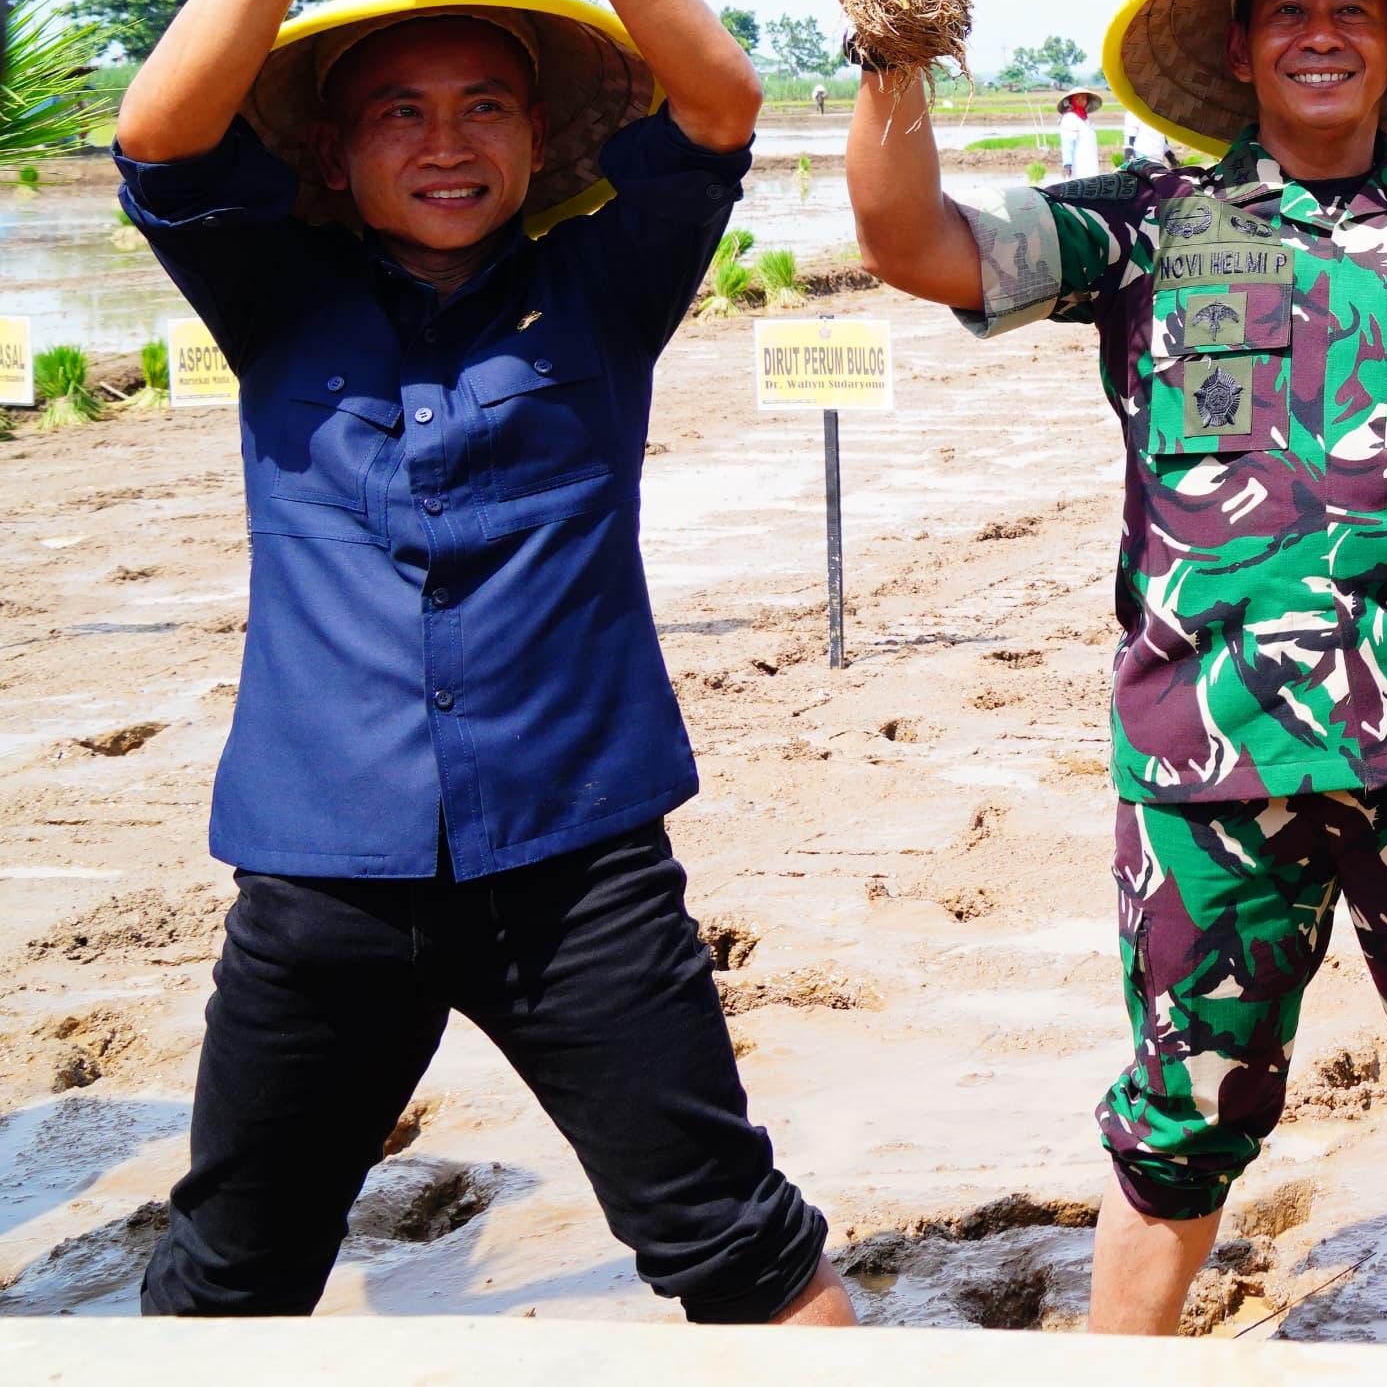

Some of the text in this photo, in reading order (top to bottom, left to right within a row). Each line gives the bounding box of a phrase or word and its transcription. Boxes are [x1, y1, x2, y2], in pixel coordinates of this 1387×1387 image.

[1159, 250, 1288, 281] NOVI HELMI P
[763, 346, 885, 376] DIRUT PERUM BULOG
[764, 379, 782, 390] Dr.
[828, 378, 886, 390] Sudaryono
